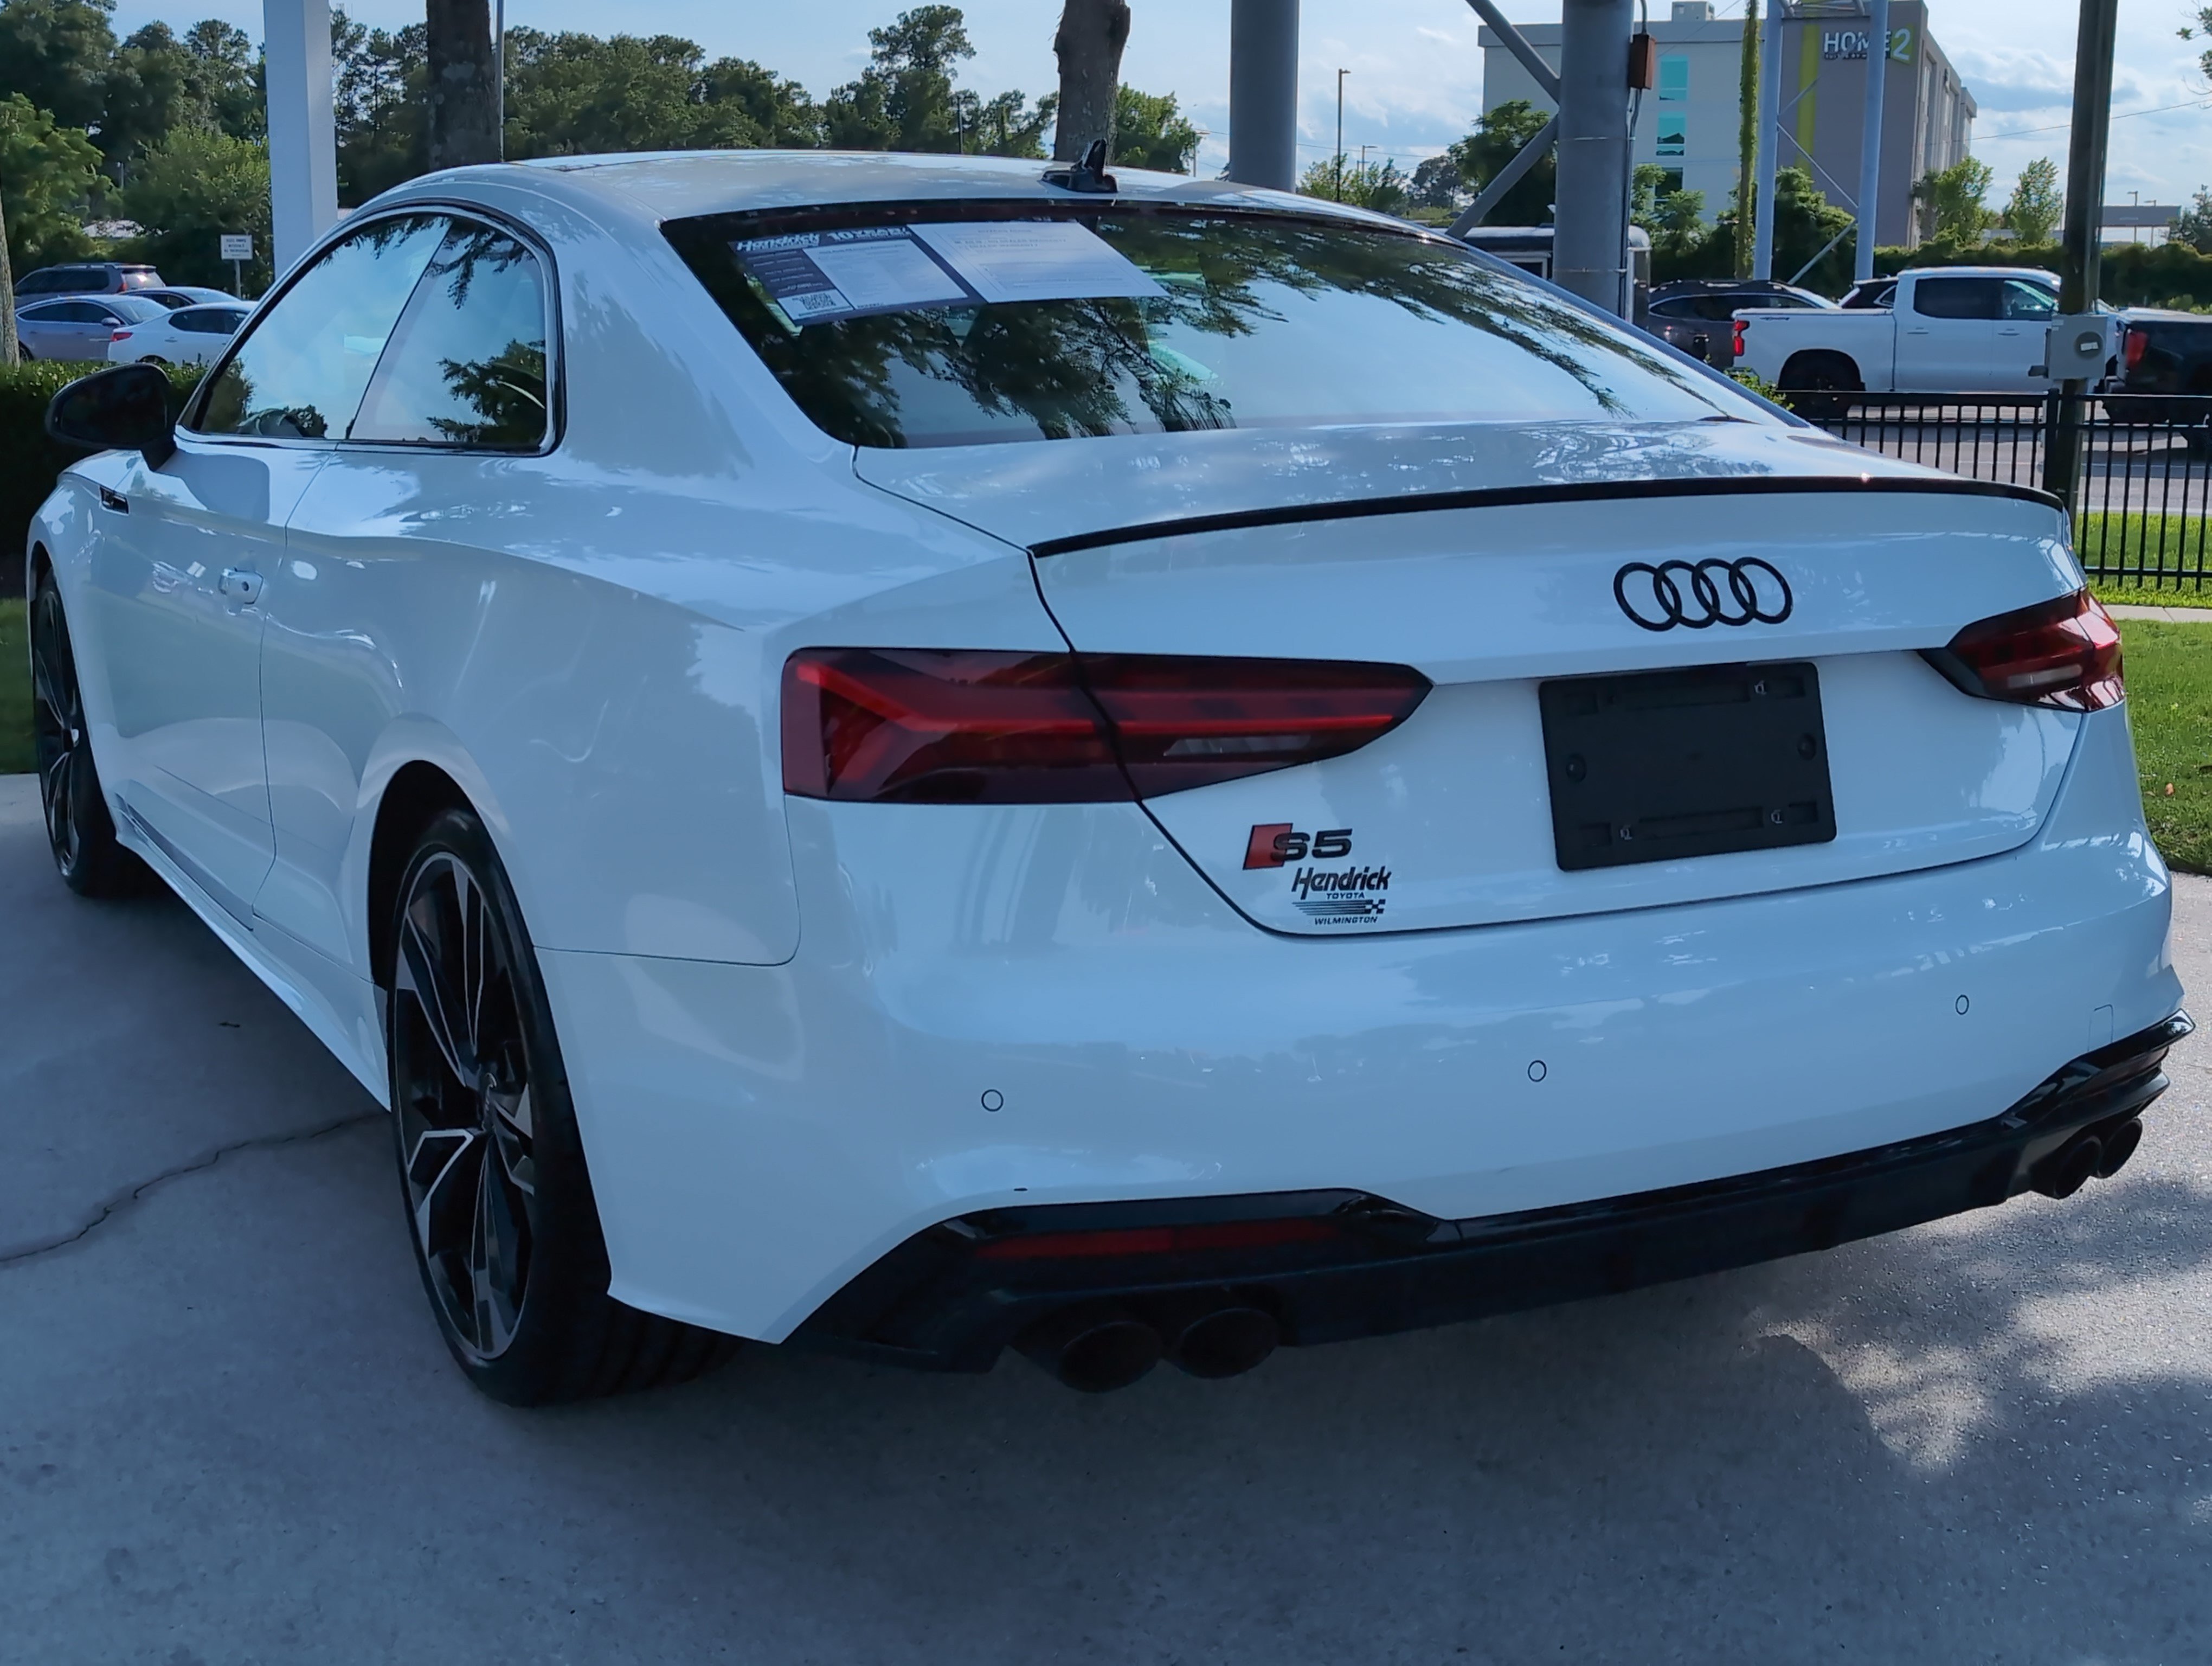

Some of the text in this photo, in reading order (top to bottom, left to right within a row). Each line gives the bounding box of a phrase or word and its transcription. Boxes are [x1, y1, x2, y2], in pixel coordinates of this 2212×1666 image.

[1271, 828, 1353, 862] S5
[1291, 866, 1392, 900] Hendrick
[1326, 892, 1365, 900] TOYOTA
[1314, 916, 1378, 926] WILMINGTON
